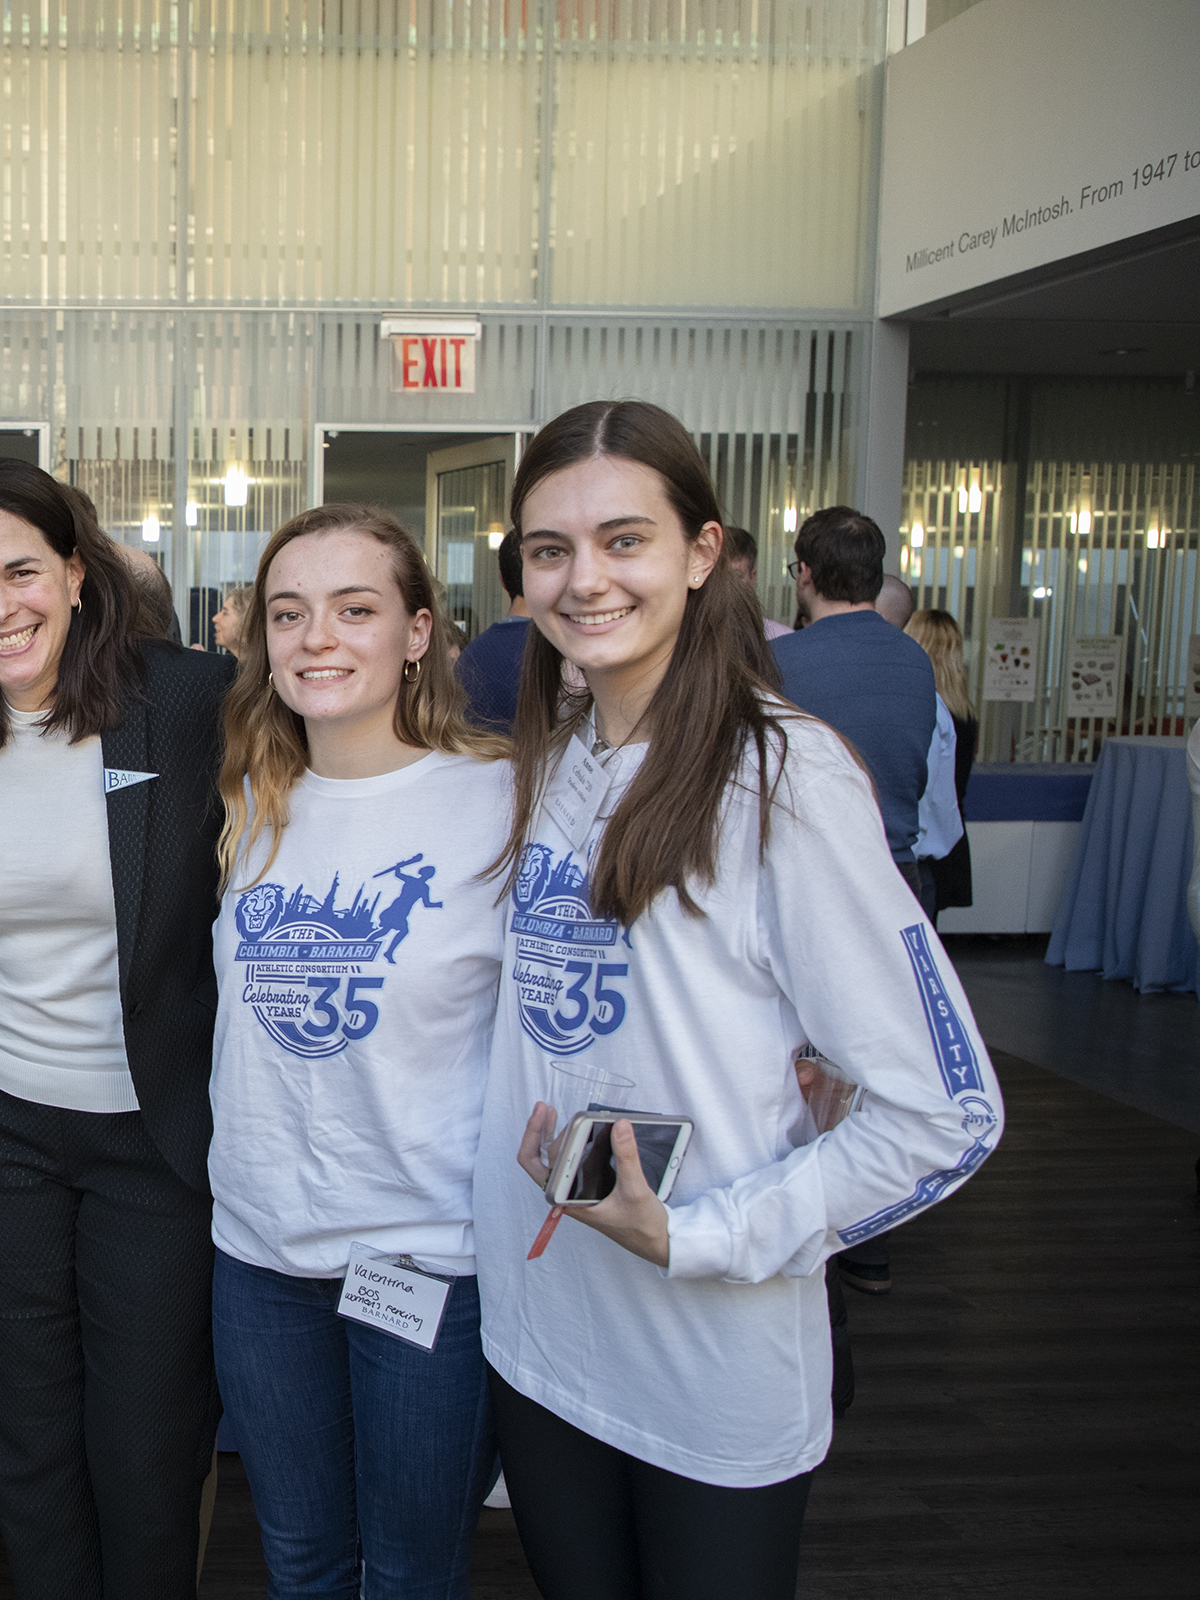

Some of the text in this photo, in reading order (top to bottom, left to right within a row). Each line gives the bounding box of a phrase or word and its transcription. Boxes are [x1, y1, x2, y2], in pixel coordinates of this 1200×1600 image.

[906, 149, 1200, 273] Millicent Carey McIntosh. From 1947 to
[402, 338, 466, 388] EXIT
[556, 904, 577, 918] THE
[291, 928, 314, 940] THE
[513, 916, 564, 938] COLUMBIA
[572, 926, 613, 942] BARNARD
[239, 945, 300, 958] COLUMBIA
[308, 945, 374, 958] BARNARD
[519, 938, 555, 953] ATHLETIC
[256, 964, 349, 974] ATHLETIC CONSORTIUM
[243, 984, 311, 1012] Celebrating
[521, 987, 555, 1006] YEARS
[553, 961, 629, 1035] 35
[908, 931, 967, 1085] VARSITY
[266, 1006, 302, 1018] YEARS
[302, 976, 386, 1041] 35
[354, 1264, 415, 1295] Valentina
[358, 1286, 380, 1300] BOS
[362, 1306, 409, 1329] BARNARD
